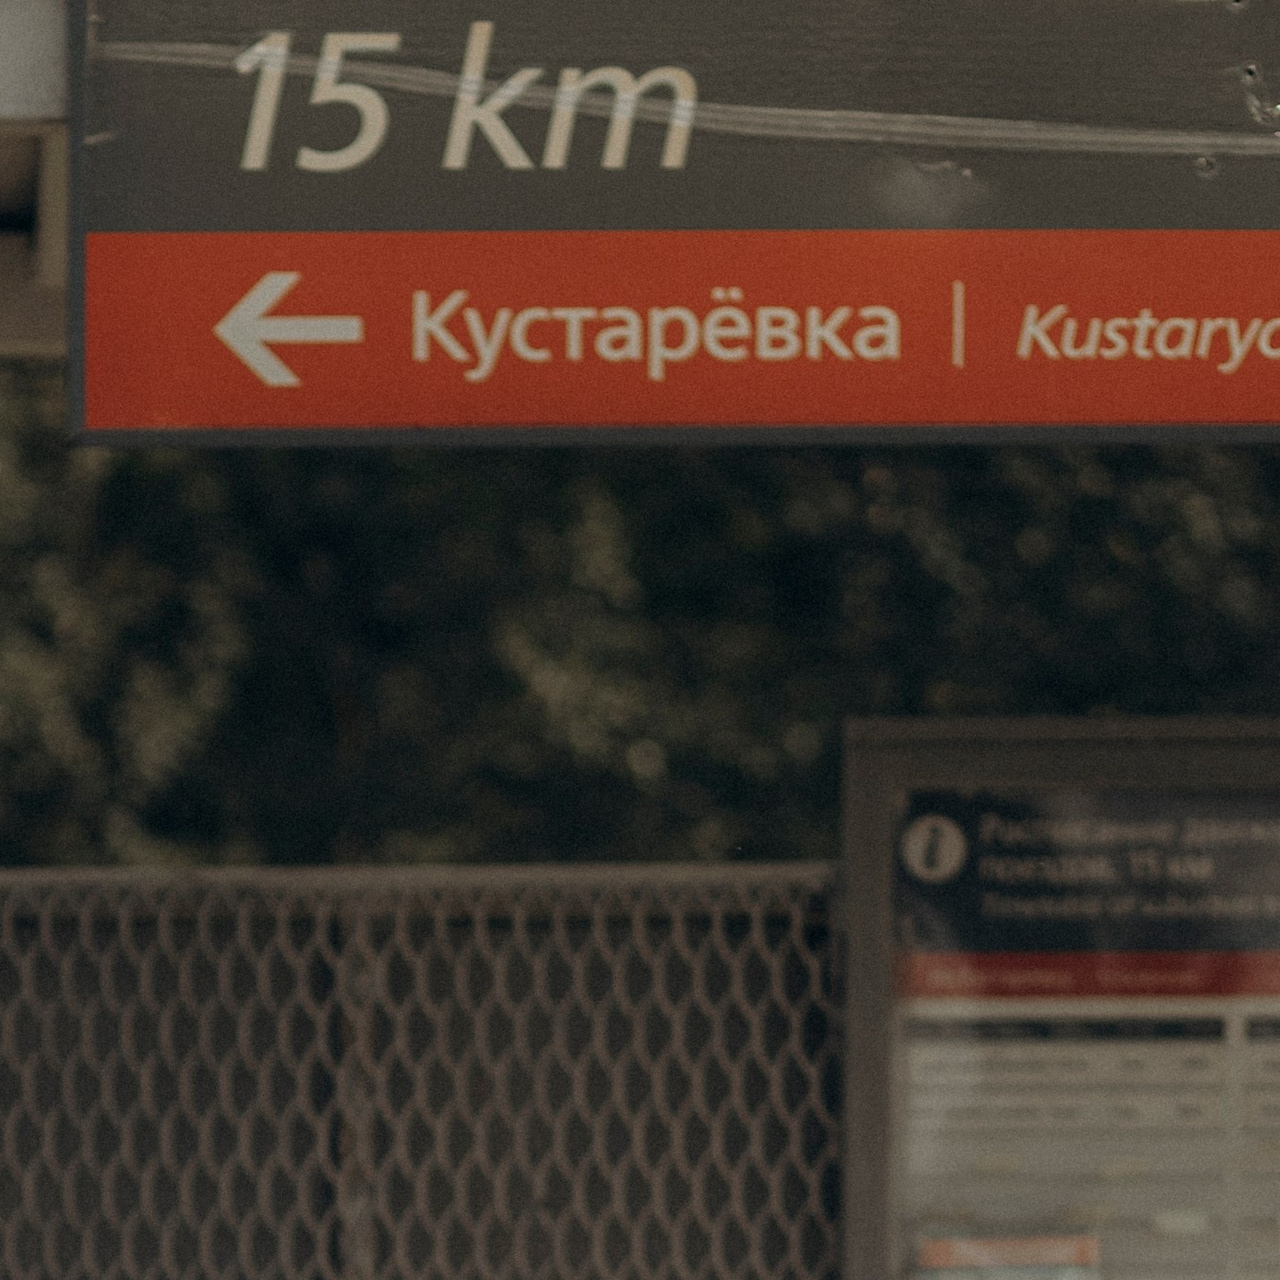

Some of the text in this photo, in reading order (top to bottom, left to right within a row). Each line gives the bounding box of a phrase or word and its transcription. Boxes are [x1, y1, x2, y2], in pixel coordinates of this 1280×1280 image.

[234, 21, 699, 172] 15 km
[411, 287, 901, 382] Кустарёвка
